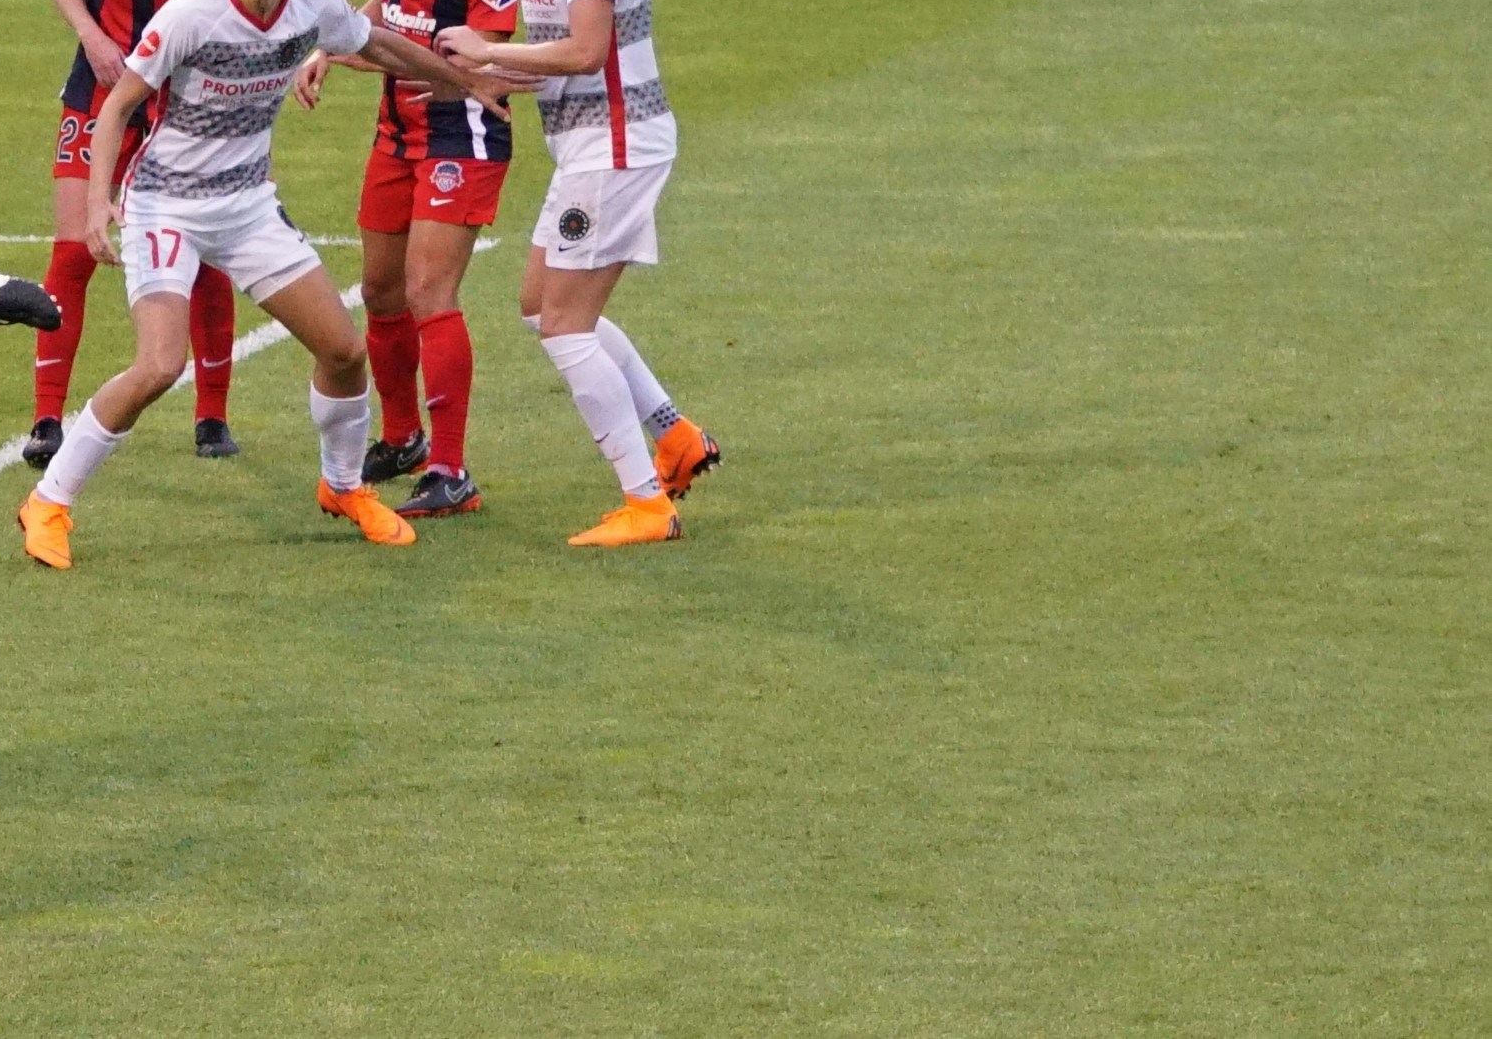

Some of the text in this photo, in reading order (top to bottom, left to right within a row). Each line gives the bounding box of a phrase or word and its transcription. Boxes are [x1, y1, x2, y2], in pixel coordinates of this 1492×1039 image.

[383, 3, 437, 33] Chain
[202, 76, 288, 96] PROVIDEN
[145, 227, 182, 270] 17
